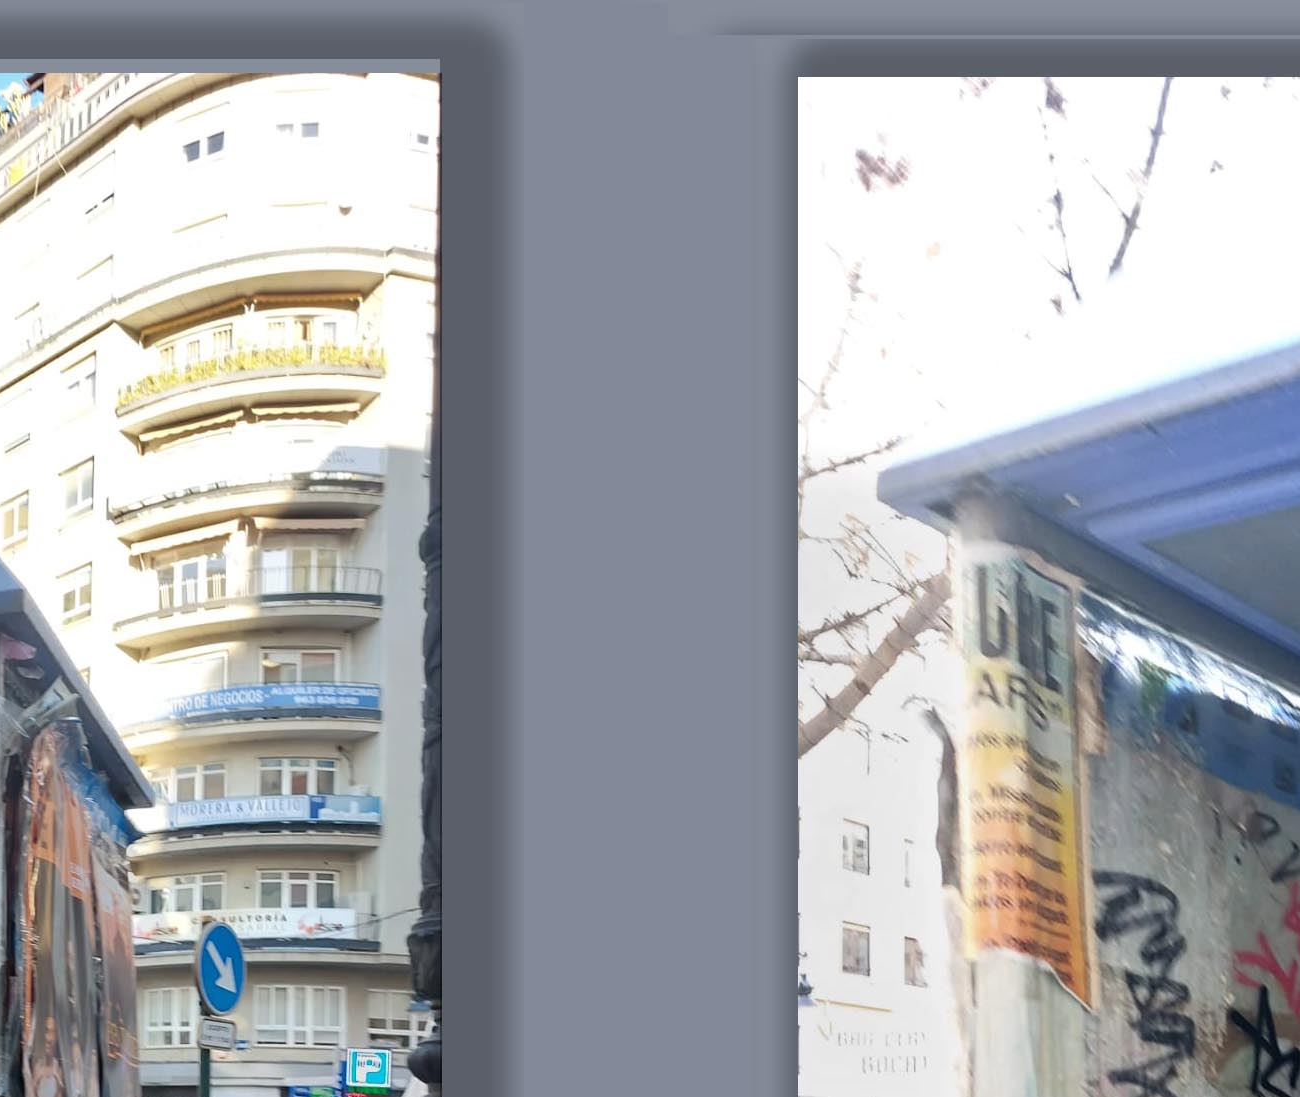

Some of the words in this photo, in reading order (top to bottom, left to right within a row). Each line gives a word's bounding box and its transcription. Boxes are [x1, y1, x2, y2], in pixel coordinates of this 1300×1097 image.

[210, 688, 264, 708] NEGOCIOS
[180, 800, 231, 817] MORERA
[356, 1054, 383, 1083] P
